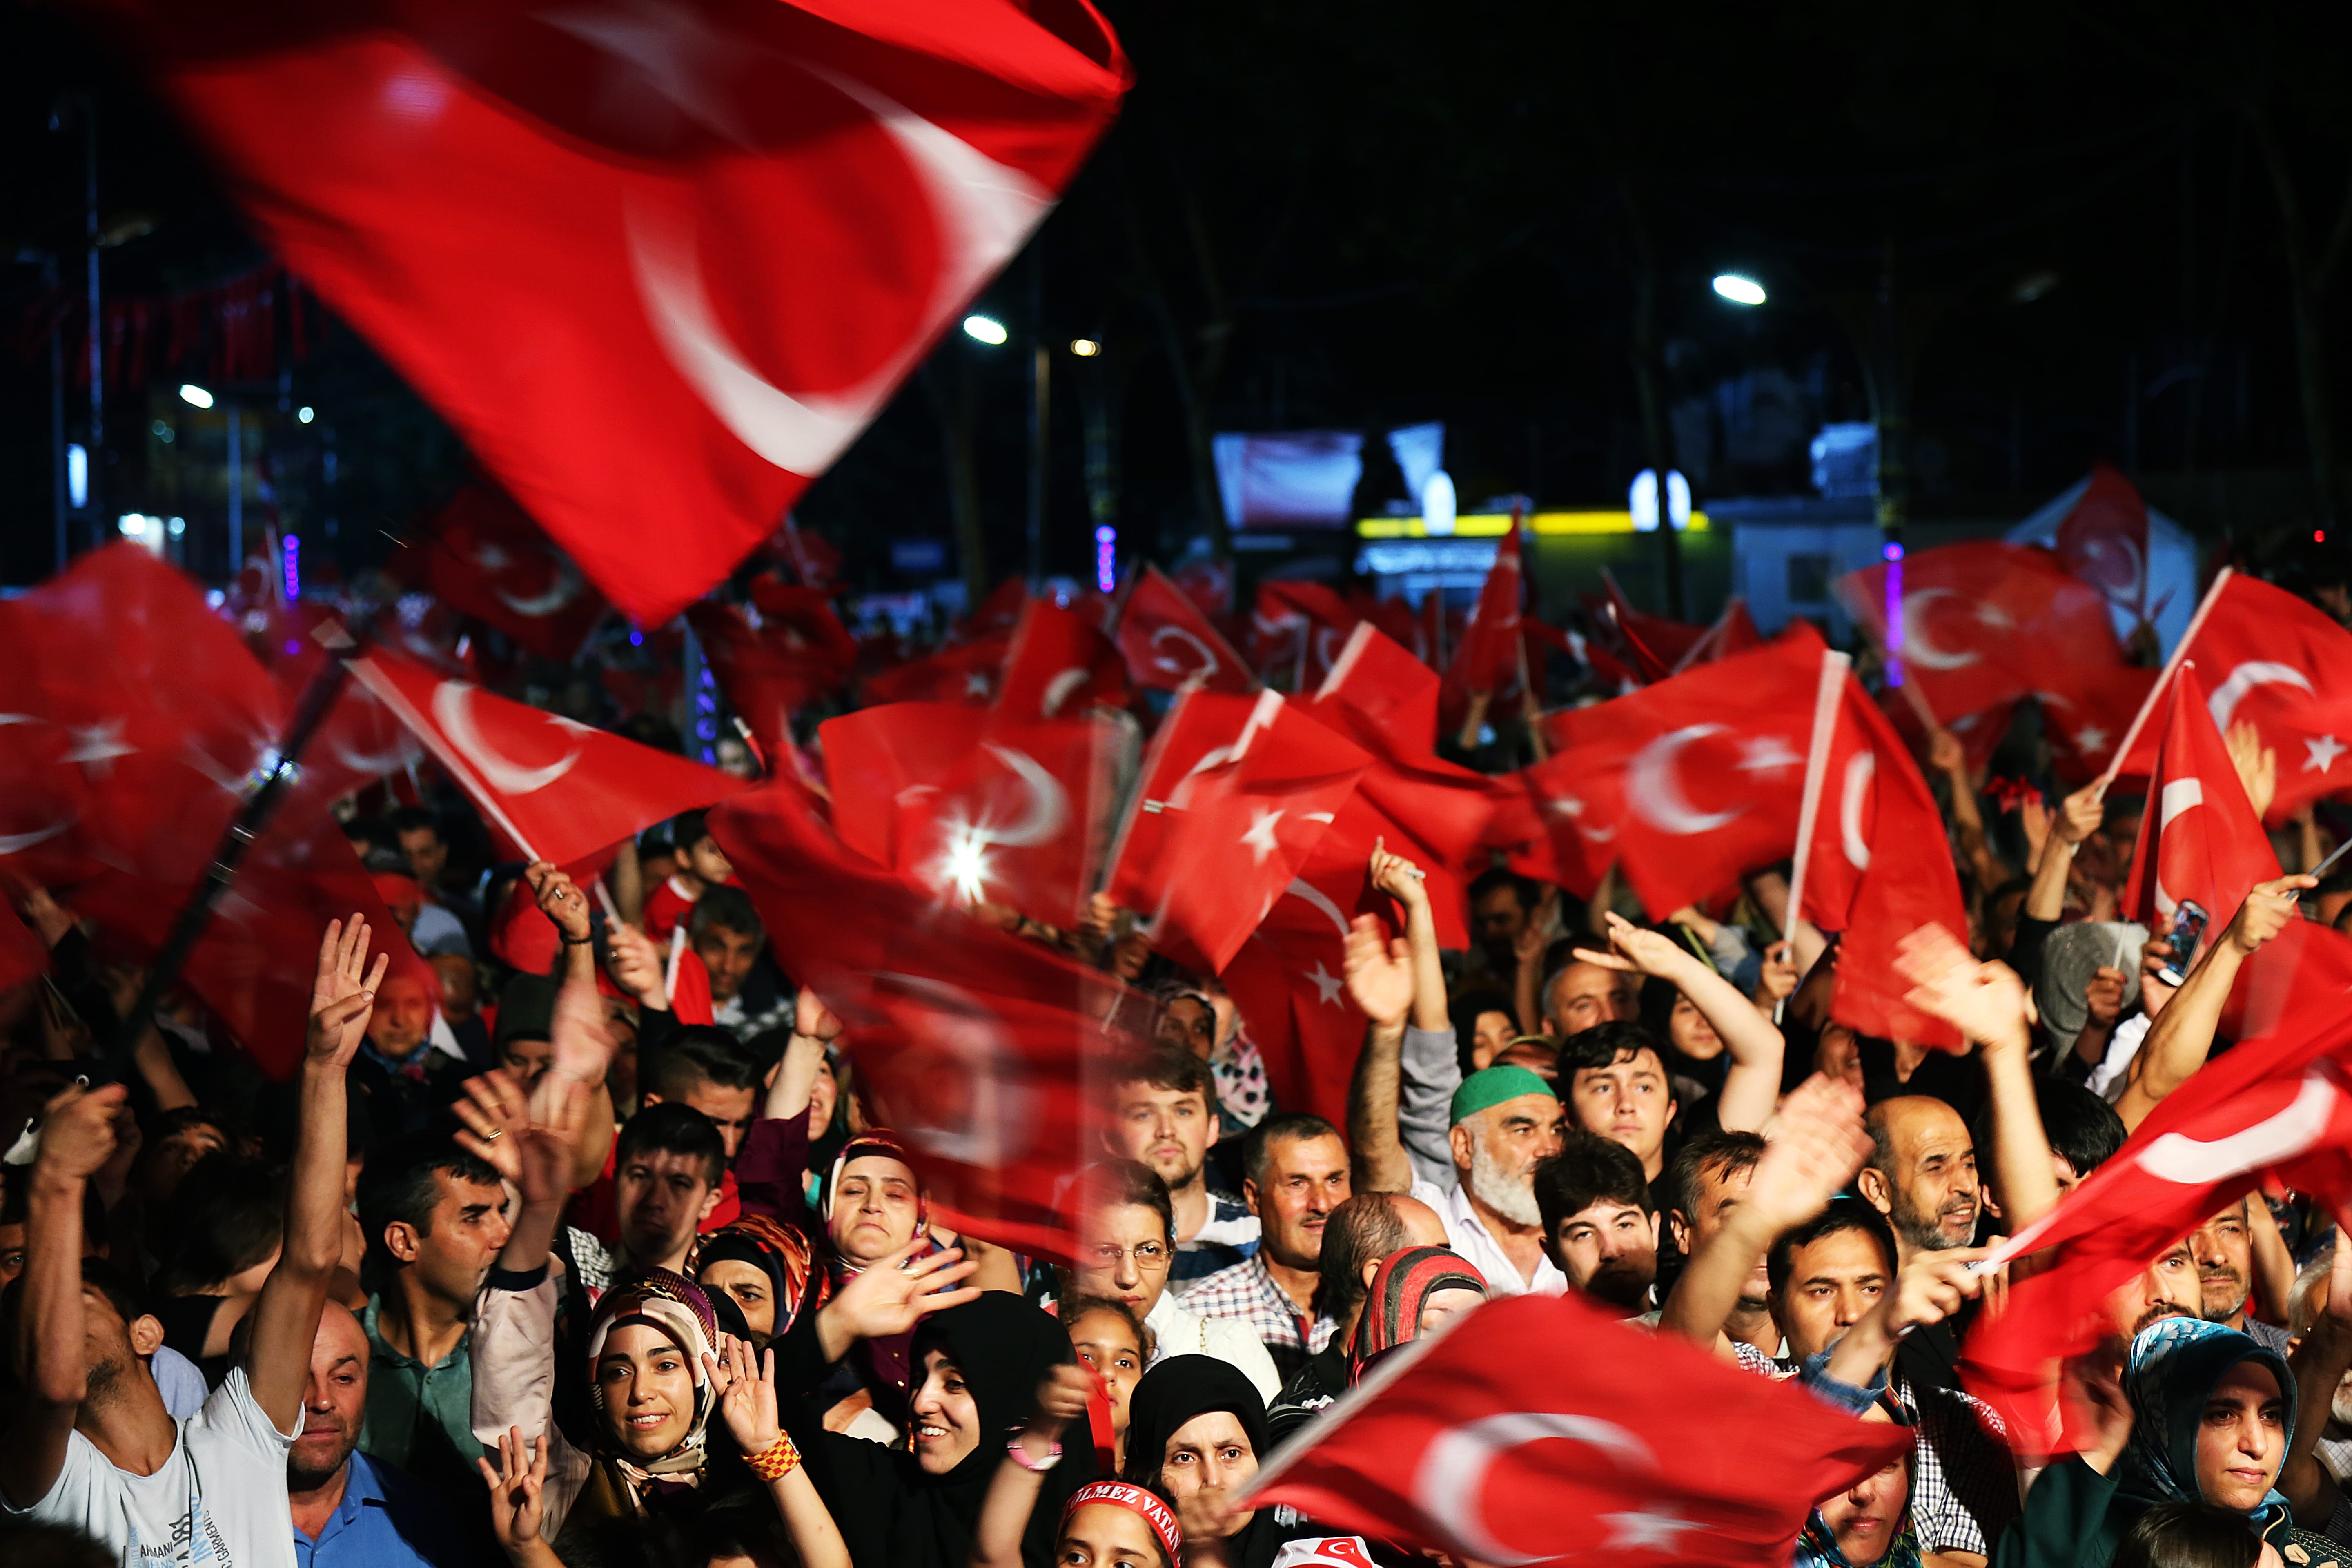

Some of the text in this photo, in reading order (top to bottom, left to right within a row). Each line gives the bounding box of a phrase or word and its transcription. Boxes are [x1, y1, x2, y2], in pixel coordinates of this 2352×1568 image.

[1069, 1485, 1181, 1552] ÖLMEZ VATAN
[140, 1541, 173, 1558] ARMANI
